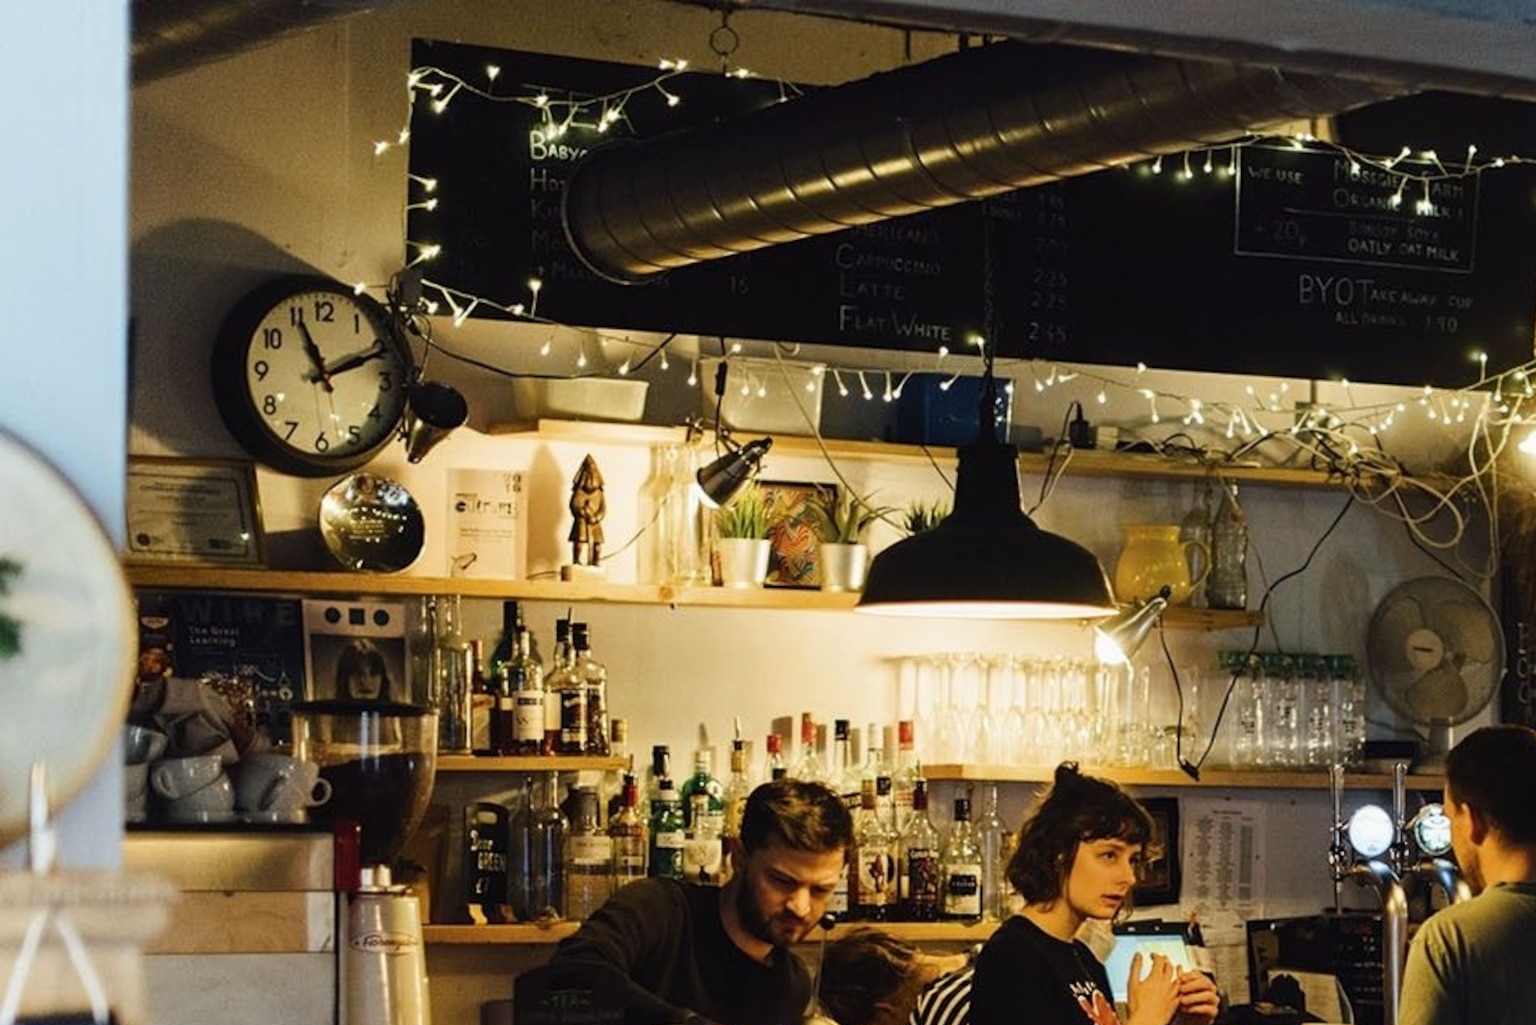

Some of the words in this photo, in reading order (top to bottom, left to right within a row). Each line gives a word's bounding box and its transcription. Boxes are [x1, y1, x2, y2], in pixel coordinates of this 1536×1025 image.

[529, 130, 589, 161] BABY
[316, 301, 334, 322] 12
[354, 314, 360, 334] 1
[839, 304, 886, 332] FLAT
[891, 309, 952, 342] WHITE
[264, 328, 281, 349] 10
[254, 361, 268, 381] 9
[379, 373, 391, 391] 3
[263, 395, 276, 415] 8
[368, 404, 382, 422] 4
[285, 422, 298, 440] 7
[348, 426, 361, 445] 5
[315, 432, 329, 452] 6
